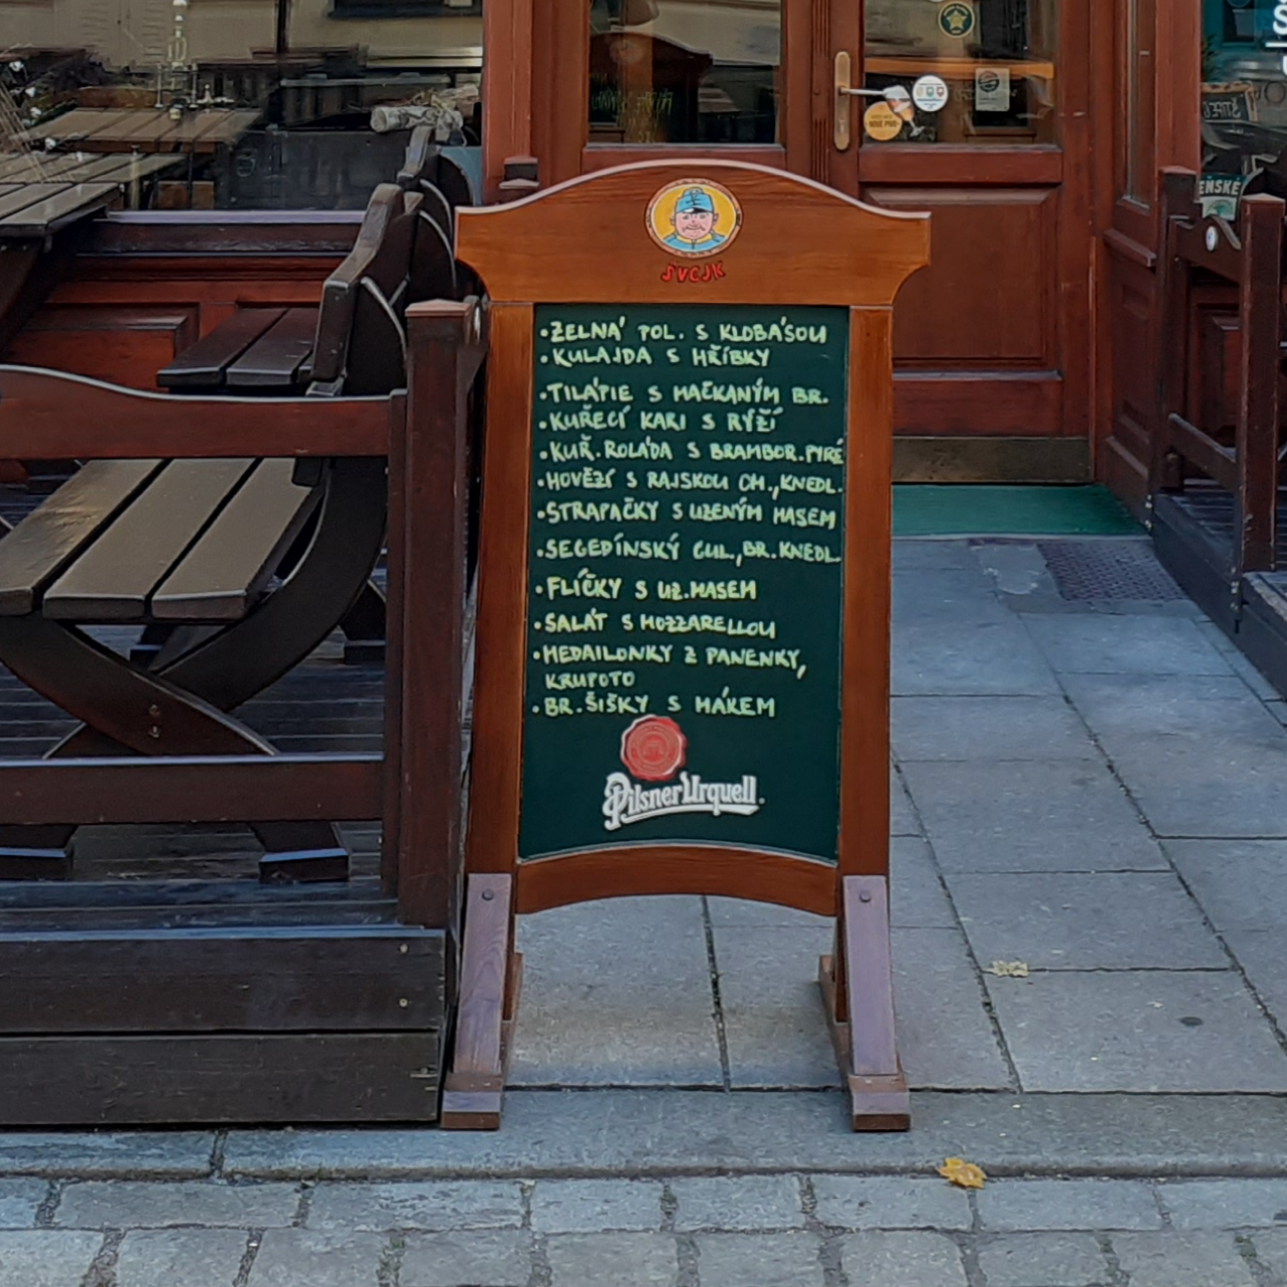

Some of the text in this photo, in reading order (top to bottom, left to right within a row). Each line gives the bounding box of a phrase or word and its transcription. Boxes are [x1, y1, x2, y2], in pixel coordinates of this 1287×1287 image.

[638, 325, 684, 341] POL.
[696, 324, 709, 341] S
[552, 344, 769, 367] KULAJDA S HŘÍBKY
[648, 386, 663, 402] S
[792, 387, 829, 404] BR.
[549, 404, 631, 431] KUŘECÍ
[640, 411, 686, 430] KARI
[702, 412, 715, 430] S
[687, 441, 700, 459] S
[626, 471, 638, 488] S
[647, 471, 729, 490] RAJSKOU
[546, 497, 659, 524] STRAPAČKY
[672, 502, 684, 520] S
[635, 580, 648, 599] S
[544, 608, 608, 633] SALÁT
[622, 614, 634, 631] S
[545, 670, 636, 690] KRUPOTO
[667, 695, 681, 712] S
[602, 771, 757, 831] Pilsner Urquell
